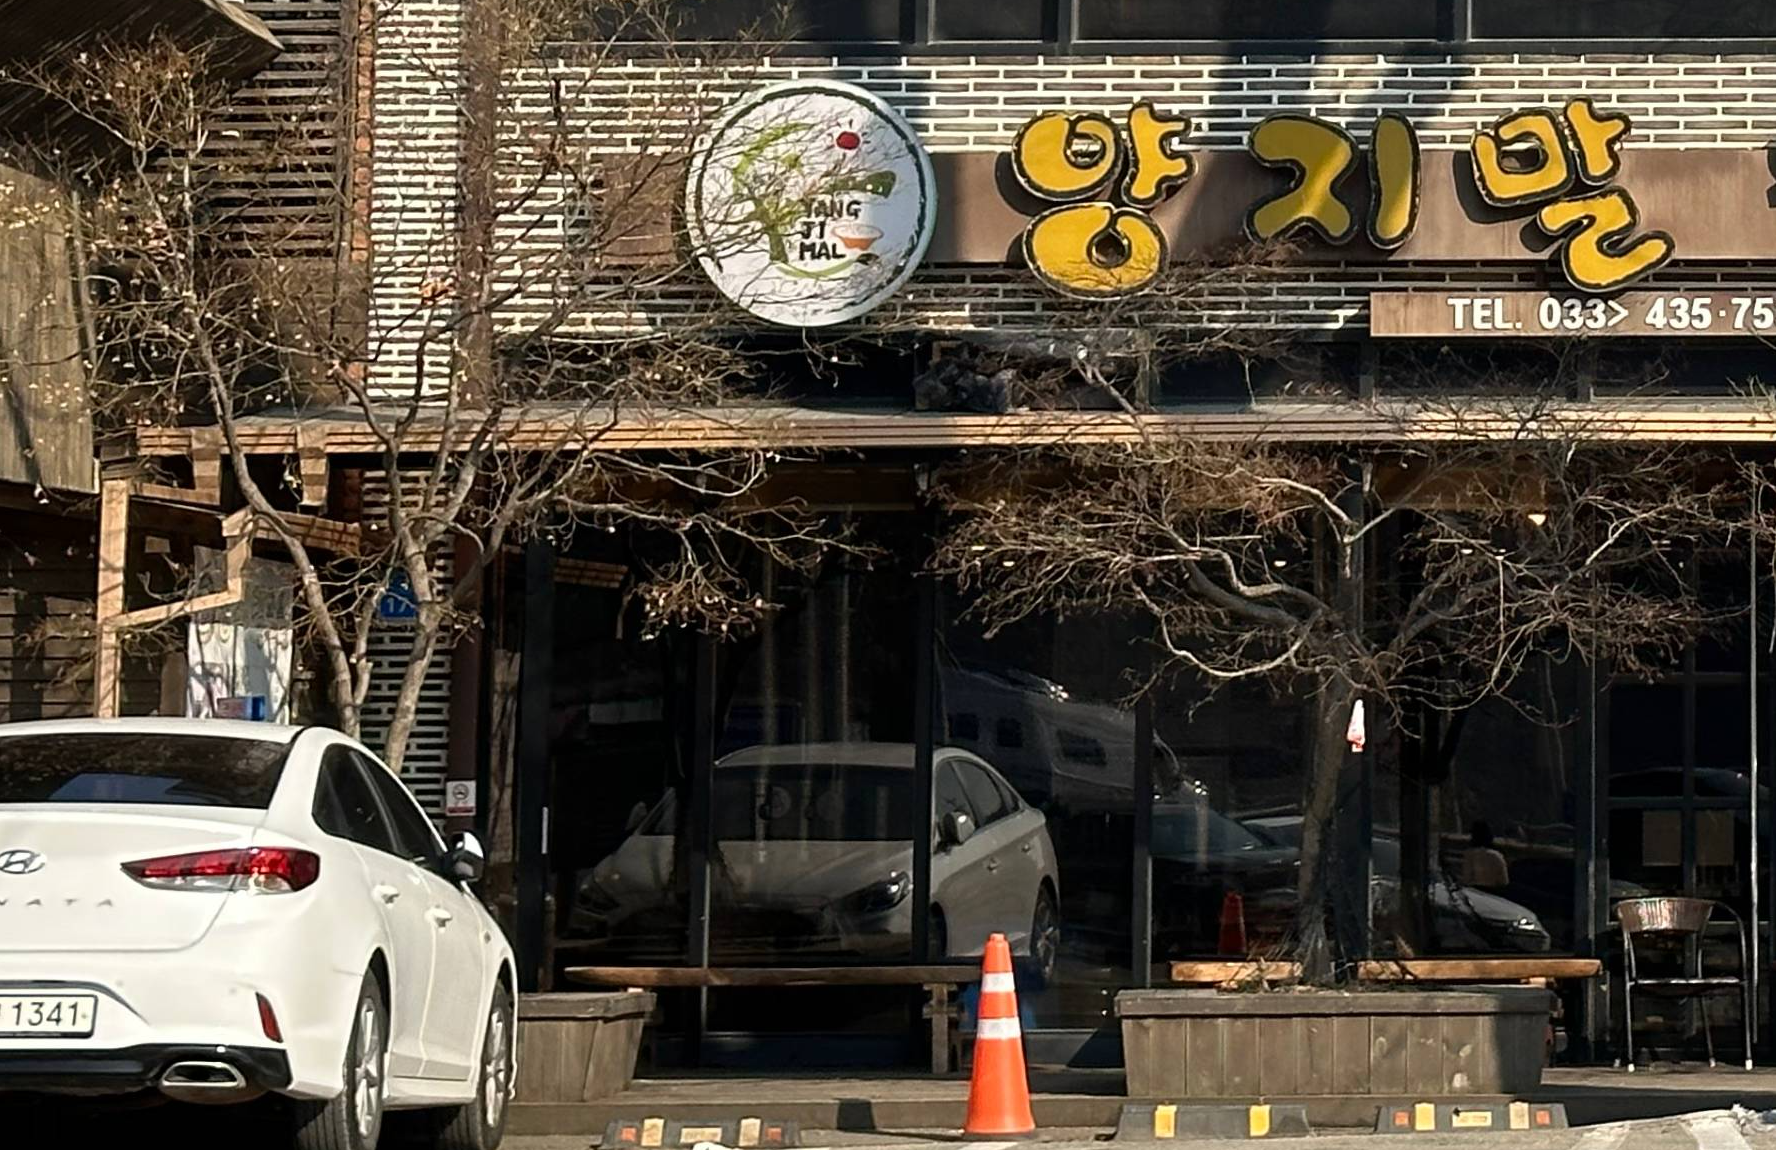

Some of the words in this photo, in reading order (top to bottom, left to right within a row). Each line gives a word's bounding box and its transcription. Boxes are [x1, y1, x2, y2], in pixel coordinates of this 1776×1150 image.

[804, 196, 862, 220] YANG
[1012, 97, 1675, 300] 양지말
[801, 221, 827, 240] JI
[799, 241, 846, 261] MAL
[1447, 298, 1522, 330] TEL.
[12, 1001, 78, 1027] 1341
